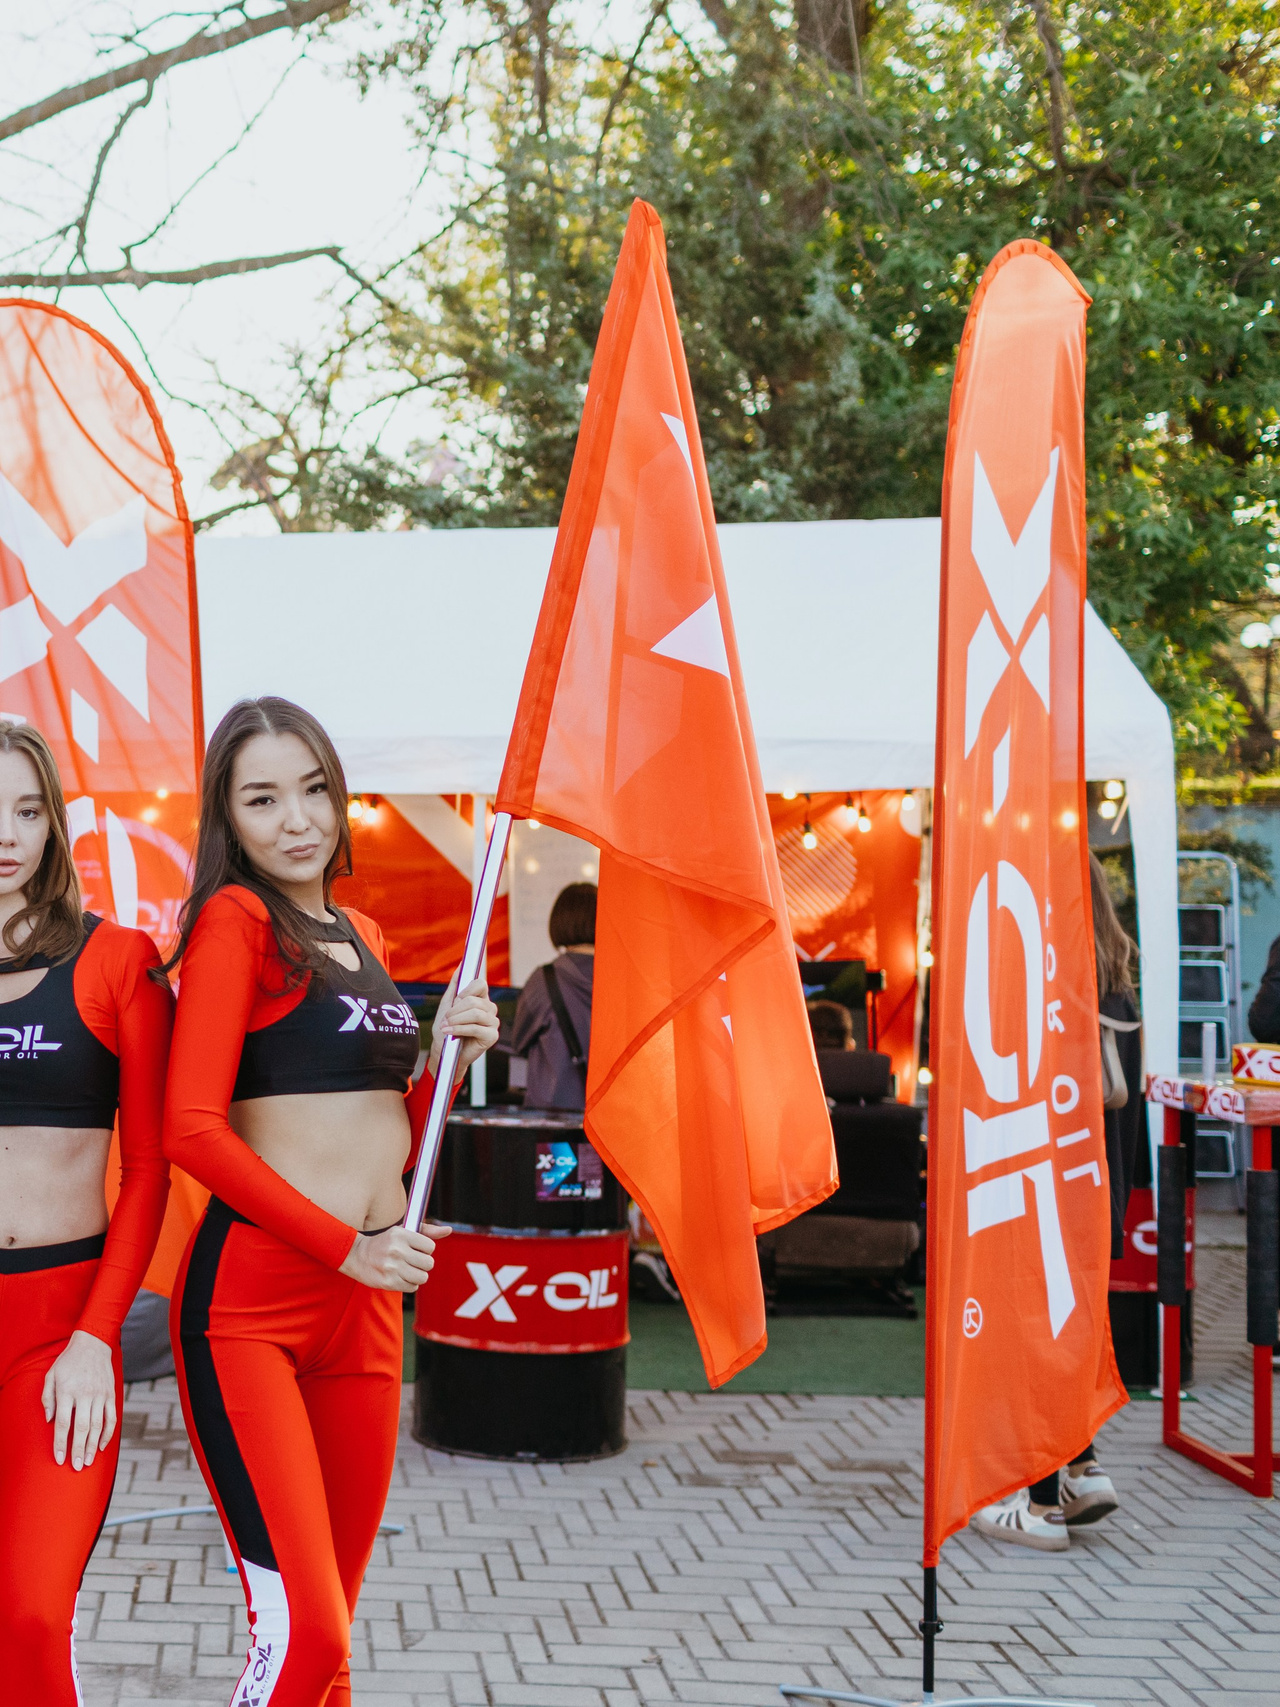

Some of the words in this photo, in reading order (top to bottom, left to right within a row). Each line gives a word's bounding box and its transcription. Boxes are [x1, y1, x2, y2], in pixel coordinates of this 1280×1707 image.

[337, 995, 420, 1032] X-OIL
[378, 1025, 404, 1034] MOTOR
[404, 1027, 416, 1035] OIL
[17, 1051, 39, 1060] OIL
